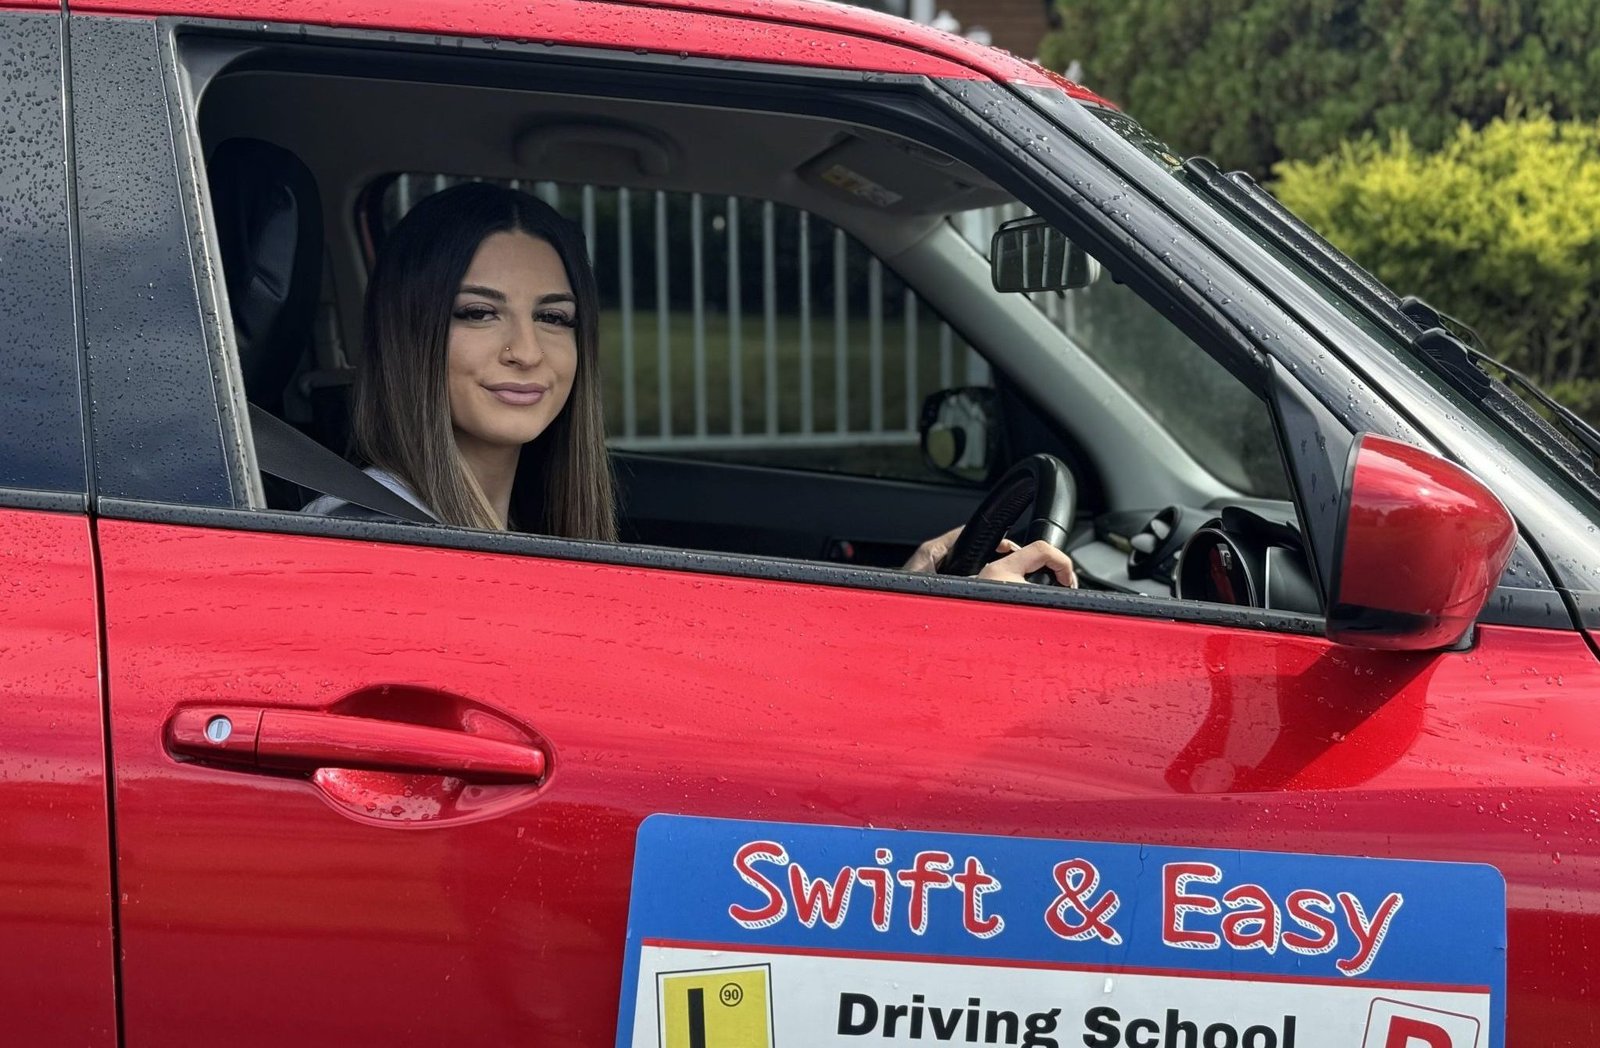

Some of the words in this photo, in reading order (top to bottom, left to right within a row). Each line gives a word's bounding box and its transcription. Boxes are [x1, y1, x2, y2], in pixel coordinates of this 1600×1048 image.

[728, 840, 1005, 939] Swift
[1044, 857, 1123, 945] &
[1161, 861, 1404, 976] Easy
[723, 989, 740, 1001] 90
[837, 991, 1062, 1048] Driving
[1082, 1006, 1297, 1048] School
